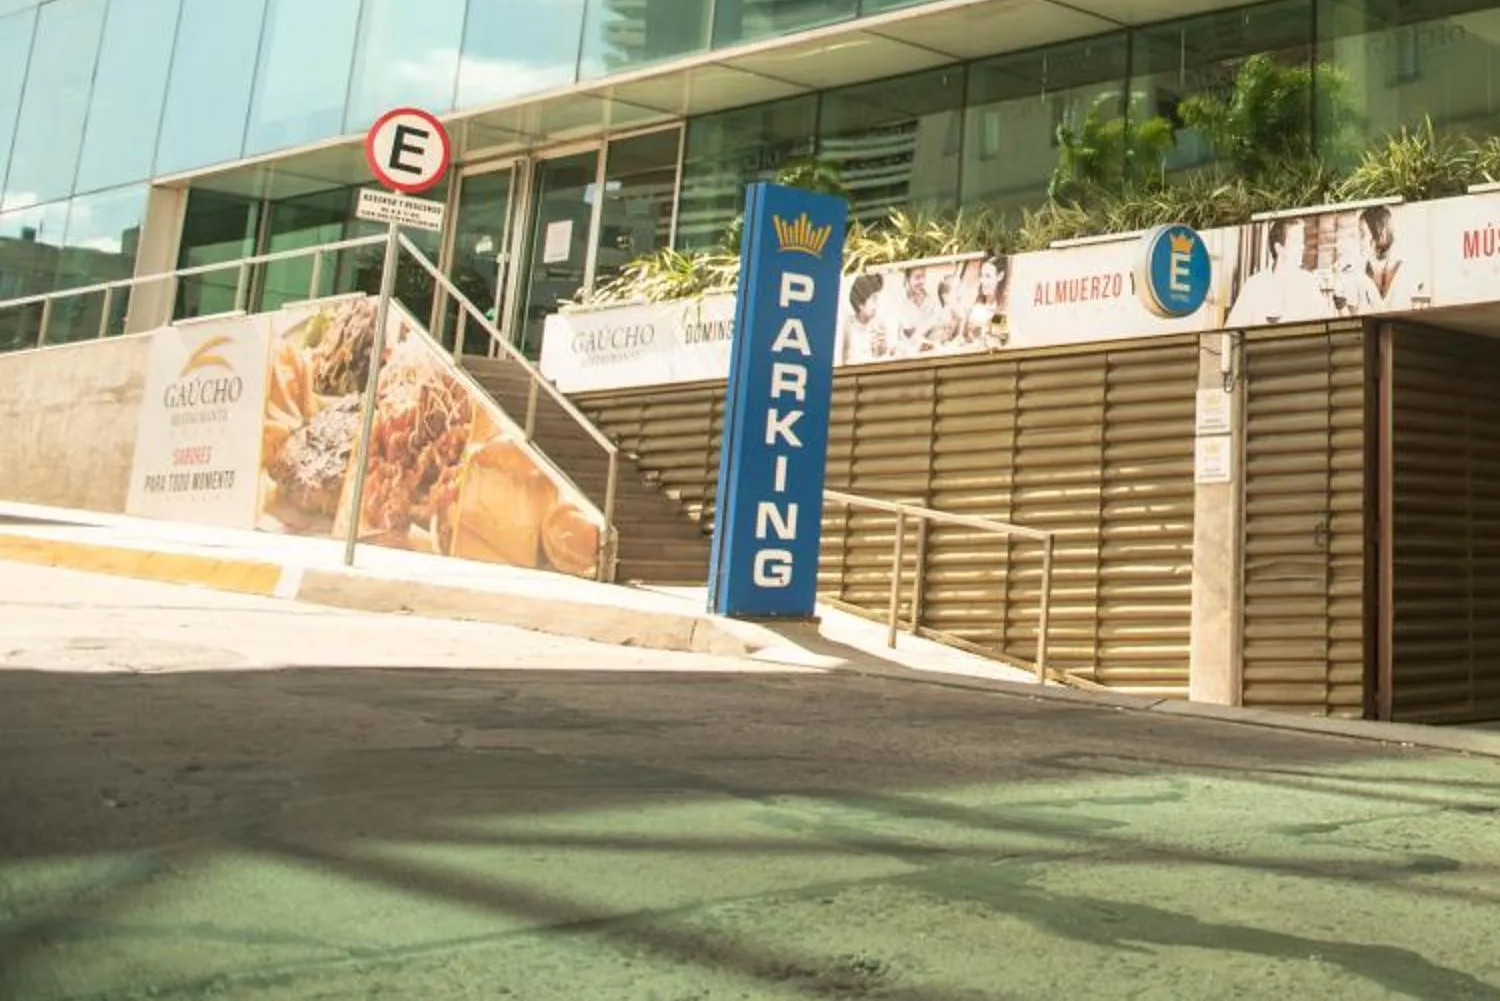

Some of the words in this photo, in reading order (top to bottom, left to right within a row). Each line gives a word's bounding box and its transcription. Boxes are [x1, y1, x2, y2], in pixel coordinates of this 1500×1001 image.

[389, 124, 430, 175] E
[1033, 272, 1124, 308] ALMUERZO
[1170, 252, 1192, 292] E
[571, 322, 655, 354] GAÚCHO
[163, 375, 243, 409] GAÚCHO
[753, 271, 815, 589] PARKING
[192, 469, 236, 491] MOMENTO
